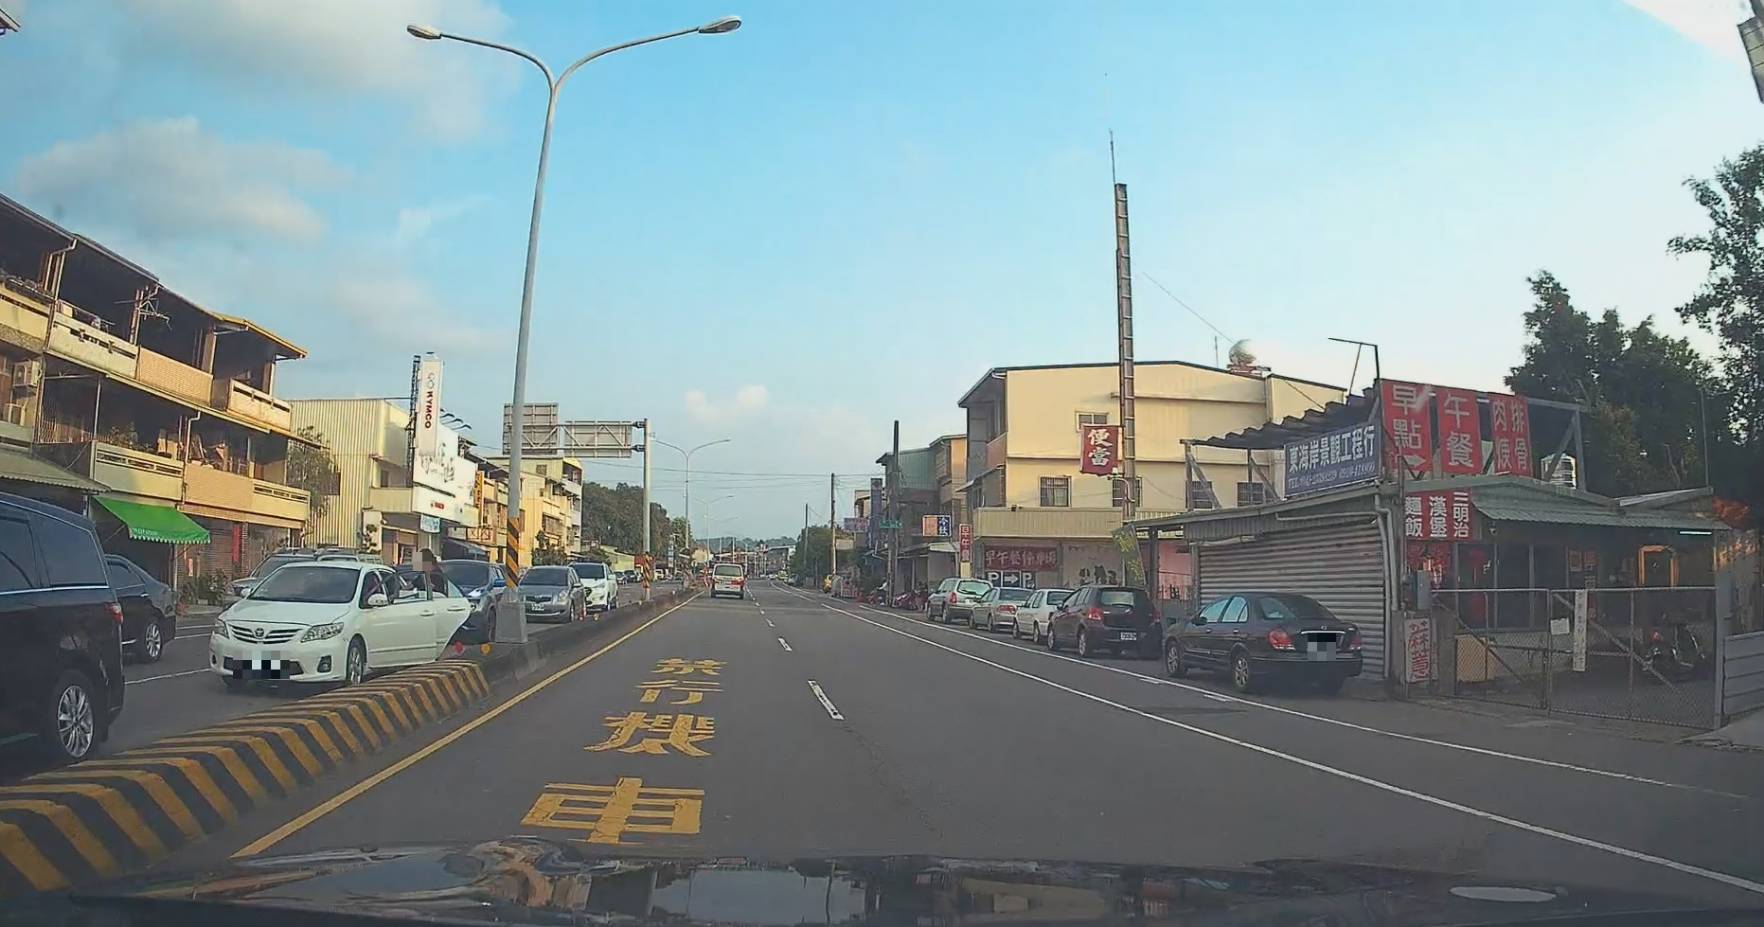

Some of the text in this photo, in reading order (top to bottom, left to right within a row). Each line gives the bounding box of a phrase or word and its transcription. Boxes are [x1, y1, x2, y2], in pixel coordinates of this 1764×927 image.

[425, 391, 434, 429] KYMCO
[1392, 385, 1422, 449] 早點
[1443, 393, 1474, 468] 午餐
[1088, 428, 1114, 466] 便當
[1289, 425, 1375, 475] 東海岸景觀工程行
[1510, 400, 1528, 470] 排骨
[1405, 496, 1423, 537] 麵飯
[1429, 496, 1447, 537] 漢堡
[1453, 491, 1469, 537] 三明治
[521, 658, 728, 844] 禁行機車
